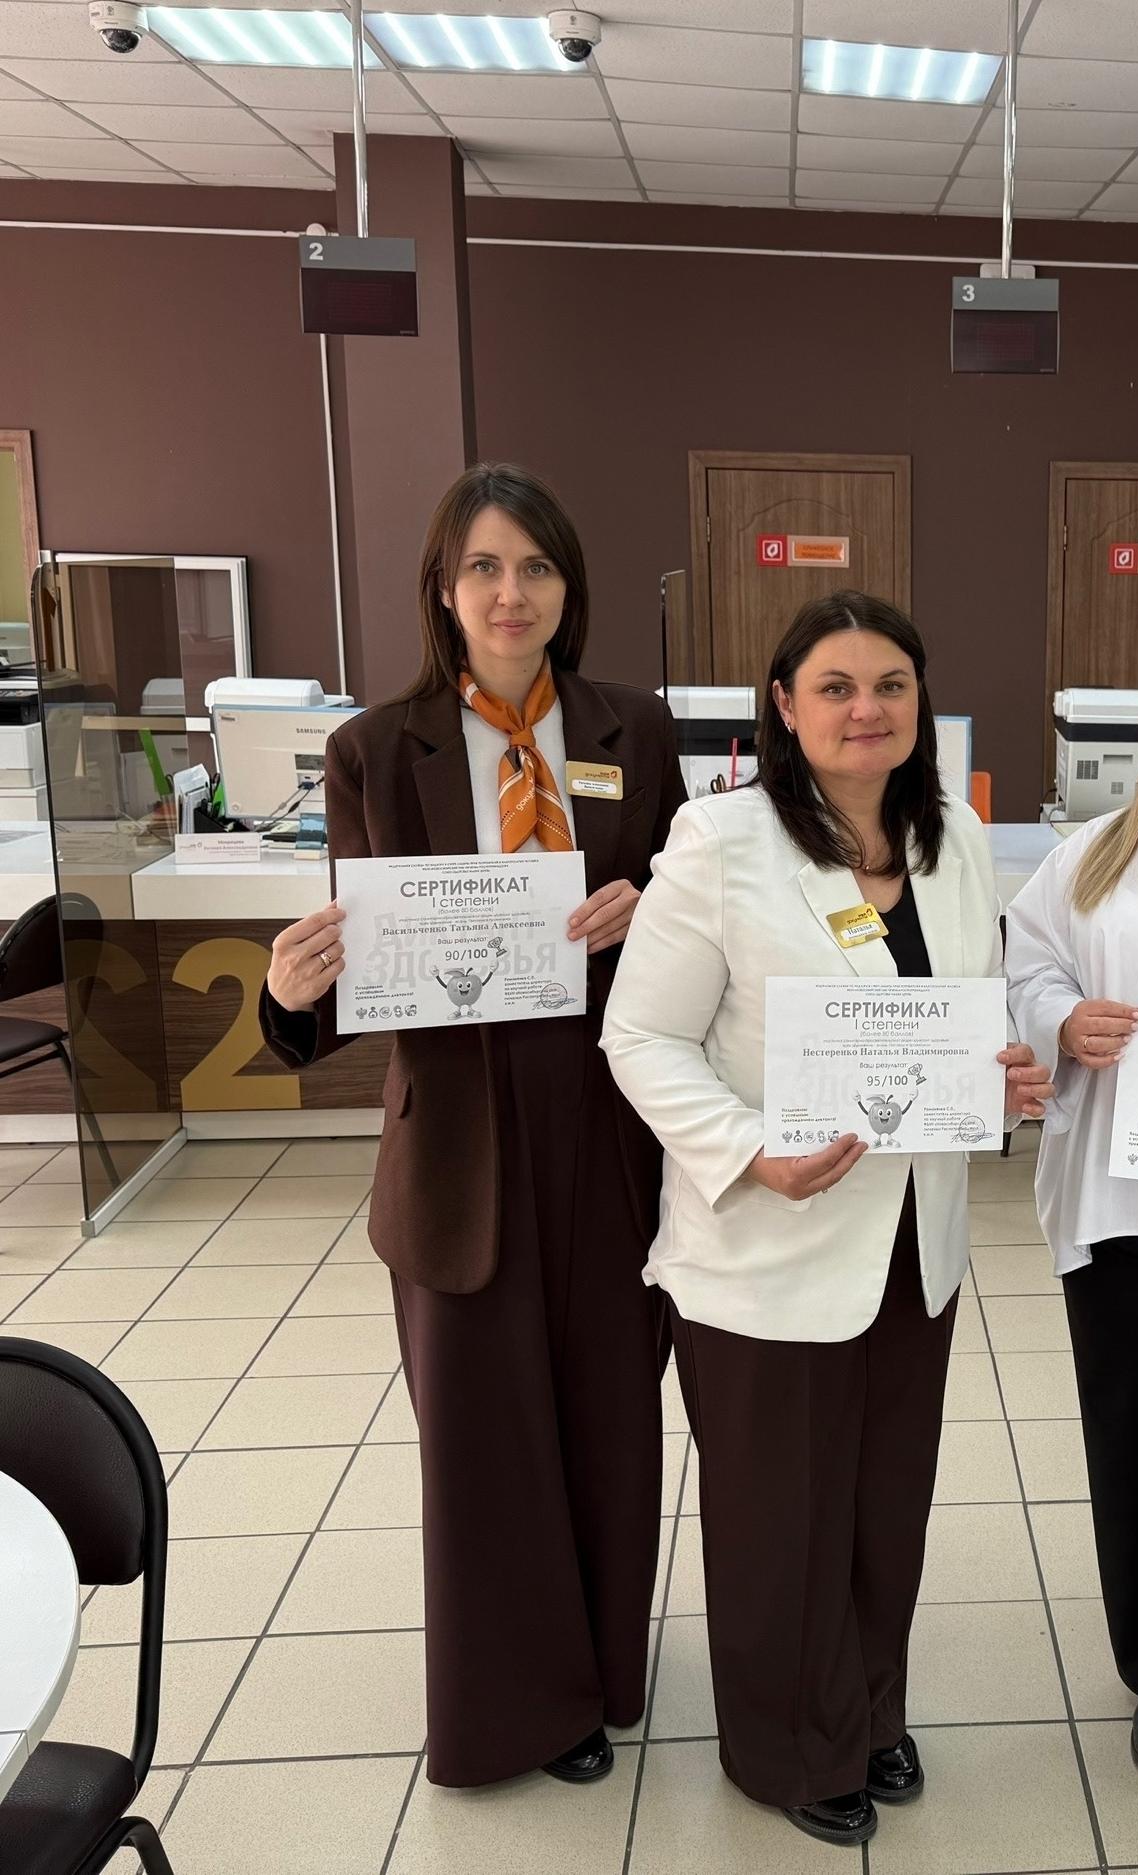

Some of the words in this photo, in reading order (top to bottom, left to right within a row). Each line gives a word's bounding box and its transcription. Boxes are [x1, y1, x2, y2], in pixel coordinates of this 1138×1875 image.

[309, 242, 324, 261] 2
[961, 284, 976, 302] 3
[400, 876, 530, 898] СЕРТИФИКАТ
[439, 897, 500, 908] степени
[382, 924, 447, 936] Васильченко
[450, 922, 489, 933] Татьяна
[490, 919, 546, 931] Алексеевна
[445, 948, 489, 962] 90/100
[824, 1001, 950, 1019] СЕРТИФИКАТ
[172, 937, 302, 1111] 2
[862, 1020, 919, 1031] степени
[802, 1047, 858, 1058] Нестеренко
[860, 1047, 900, 1057] Наталья
[902, 1047, 970, 1058] Владимировна
[866, 1075, 908, 1087] 95/100
